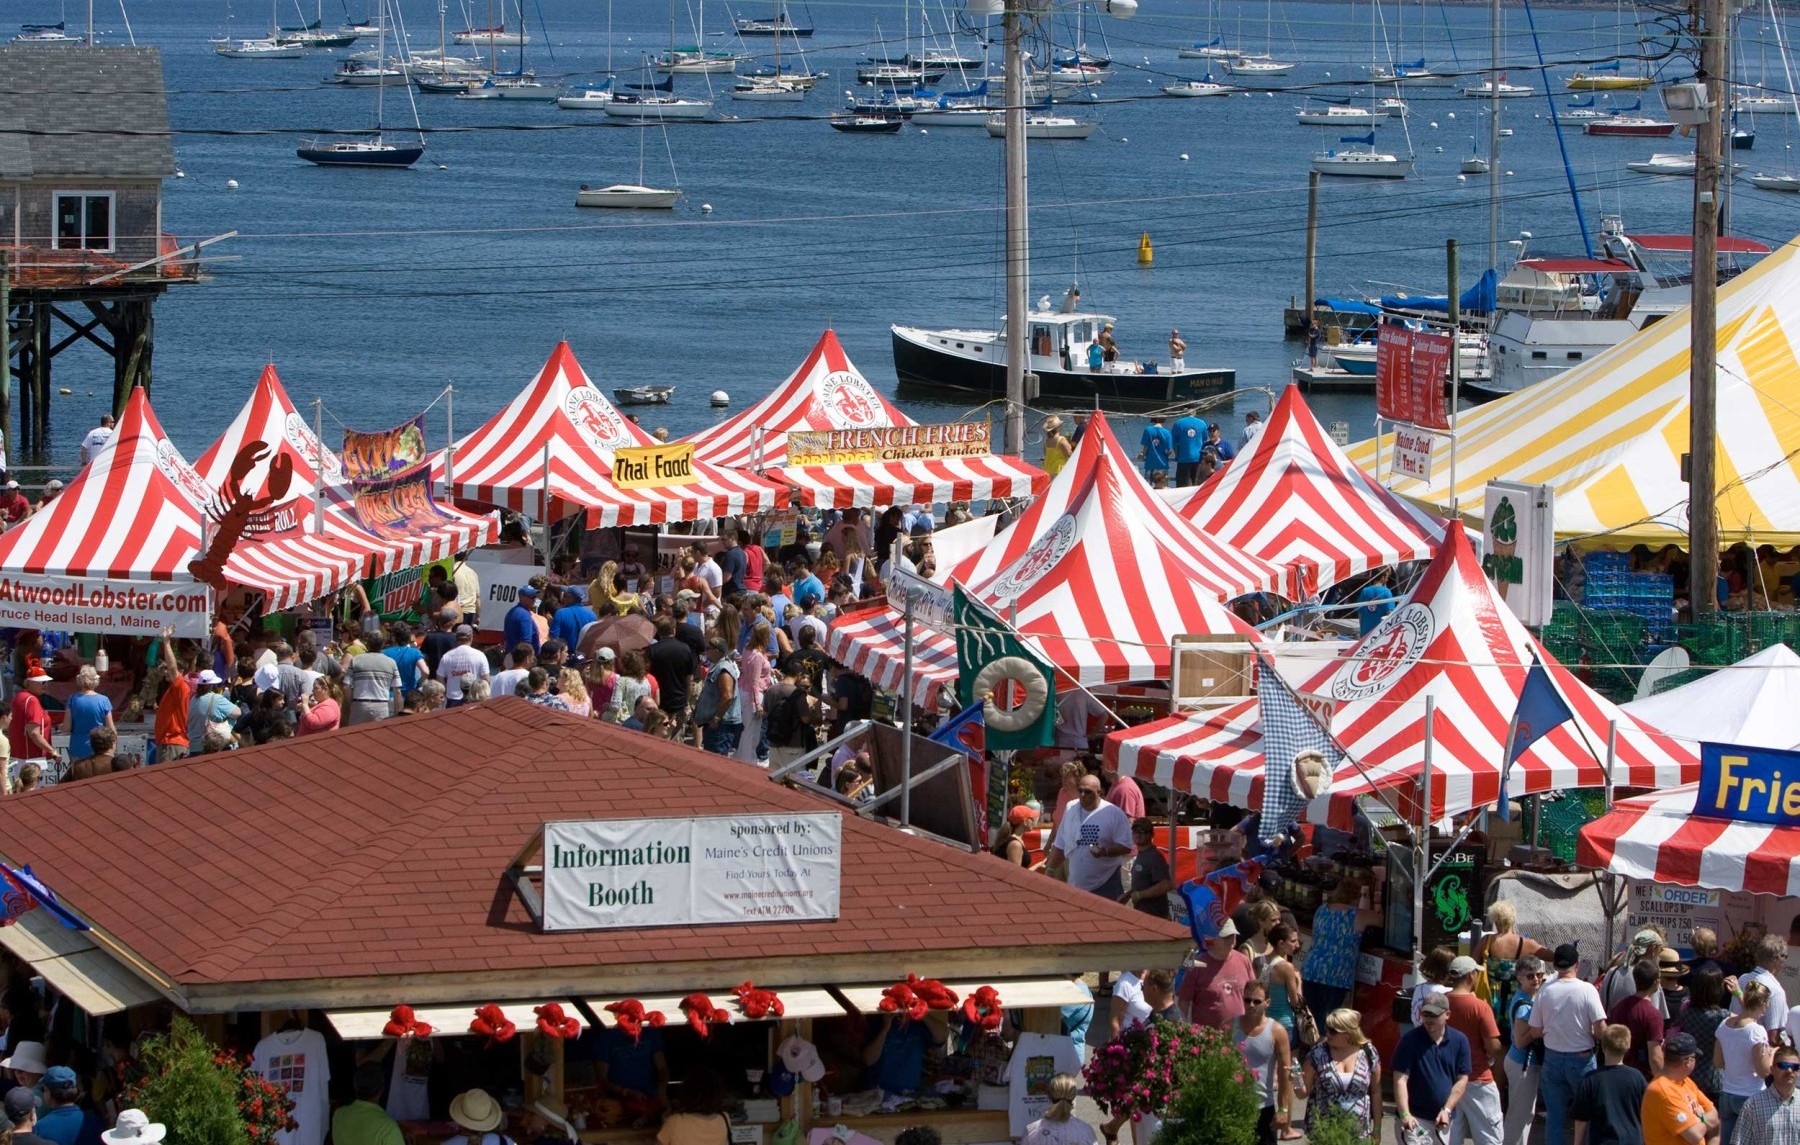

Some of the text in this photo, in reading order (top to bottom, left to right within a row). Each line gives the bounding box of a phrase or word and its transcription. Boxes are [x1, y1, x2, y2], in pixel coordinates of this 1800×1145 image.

[827, 425, 920, 450] FRENCH
[925, 422, 987, 444] FRIES
[792, 451, 874, 466] CORN DOGS
[882, 444, 988, 460] Chicken Tenders
[616, 453, 691, 481] Thai Food
[274, 507, 298, 532] ROLL
[490, 584, 518, 602] FOOD
[0, 608, 160, 629] ruce Head Island, Maine
[1355, 607, 1429, 665] MAINE LOBSTER
[730, 820, 811, 839] sponsored by:
[552, 841, 691, 869] Information
[705, 844, 833, 859] Maine's Credit Unions
[726, 868, 811, 881] Find Yours Today At
[588, 880, 654, 907] Booth
[1664, 889, 1708, 904] ORDER
[743, 907, 757, 915] Text
[758, 906, 772, 915] ATM
[1641, 901, 1679, 914] SCALLOPS
[1629, 915, 1648, 927] CLAM
